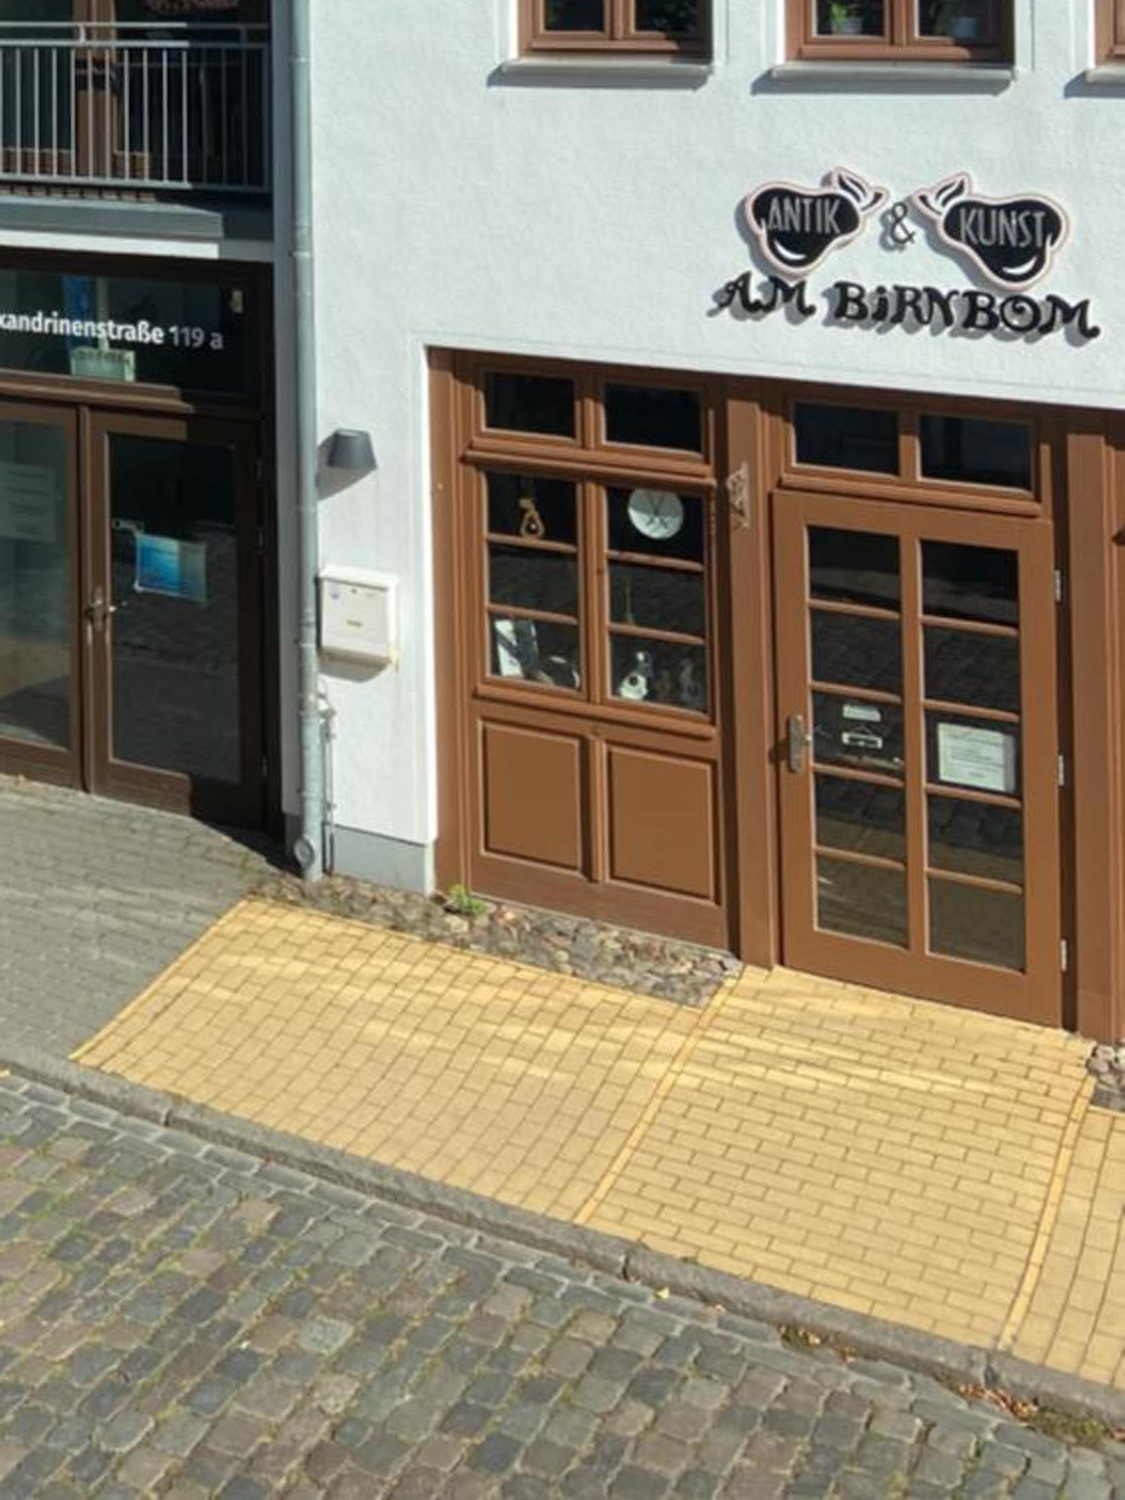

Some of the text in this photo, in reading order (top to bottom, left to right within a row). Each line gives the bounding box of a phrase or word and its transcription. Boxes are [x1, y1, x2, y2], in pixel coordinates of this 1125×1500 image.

[766, 196, 1047, 249] ANTIK & KUNST
[715, 270, 817, 315] AM
[169, 325, 205, 349] 119
[209, 331, 224, 350] a
